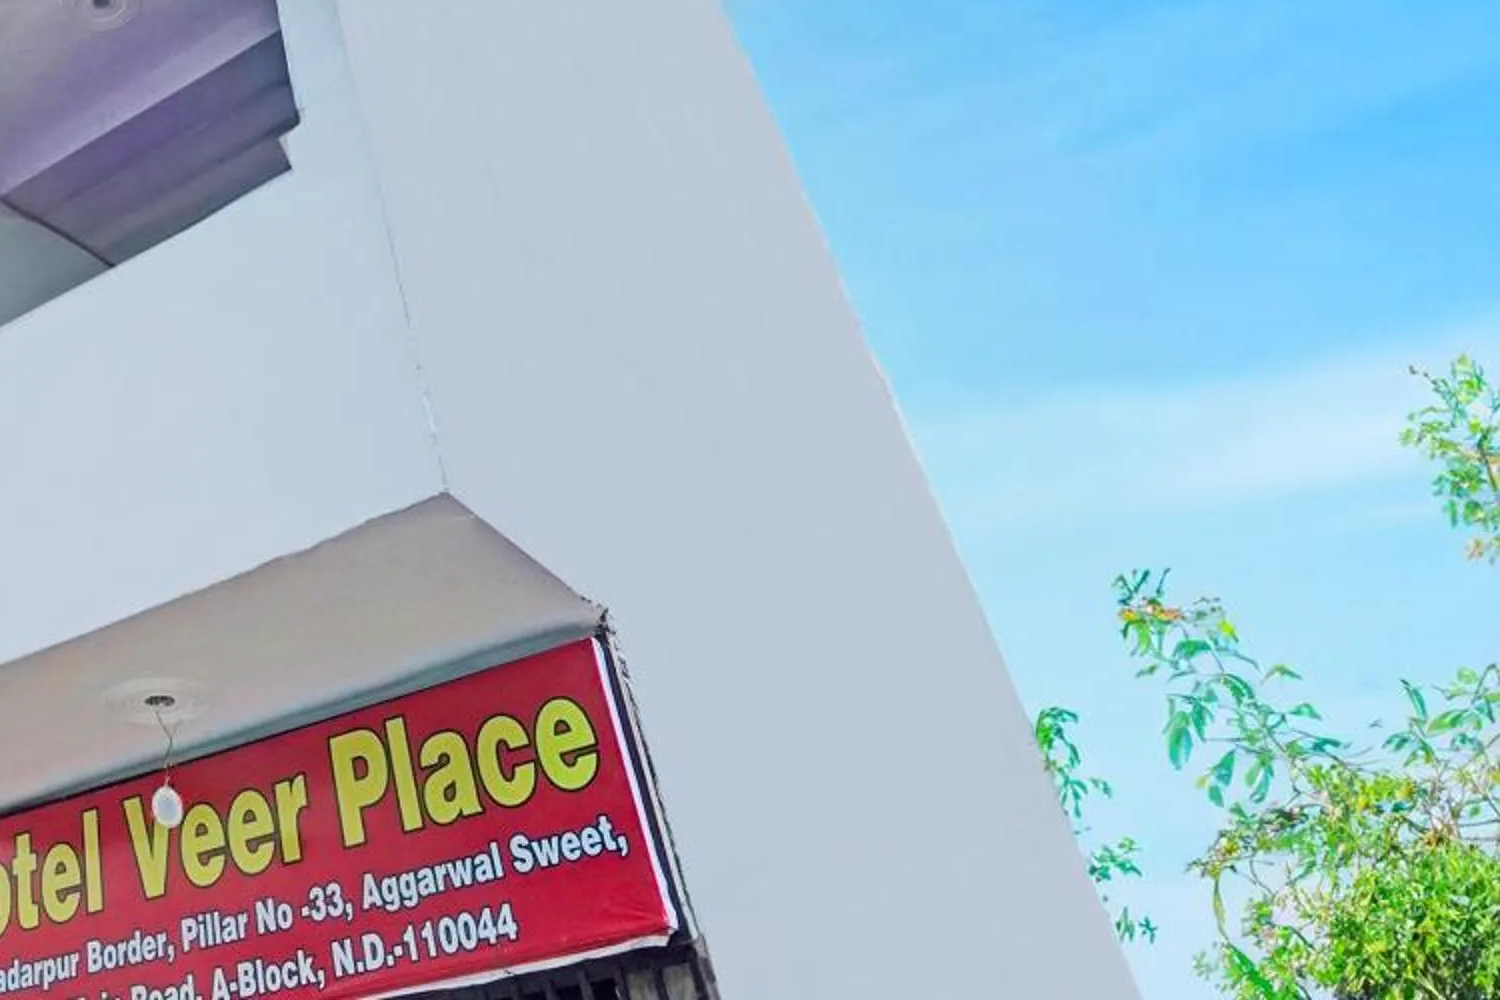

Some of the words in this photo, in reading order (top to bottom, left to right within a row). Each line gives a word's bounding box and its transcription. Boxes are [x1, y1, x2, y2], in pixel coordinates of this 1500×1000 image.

[122, 772, 309, 899] Veer
[328, 696, 598, 848] Place
[86, 930, 175, 973] Border,
[180, 911, 248, 951] Pillar
[255, 897, 293, 934] No
[362, 842, 504, 911] Aggarwal
[509, 815, 628, 873] Sweet,
[130, 974, 202, 1000] Rad
[212, 950, 325, 1000] A-Block,
[331, 904, 518, 978] N.D.-110044
